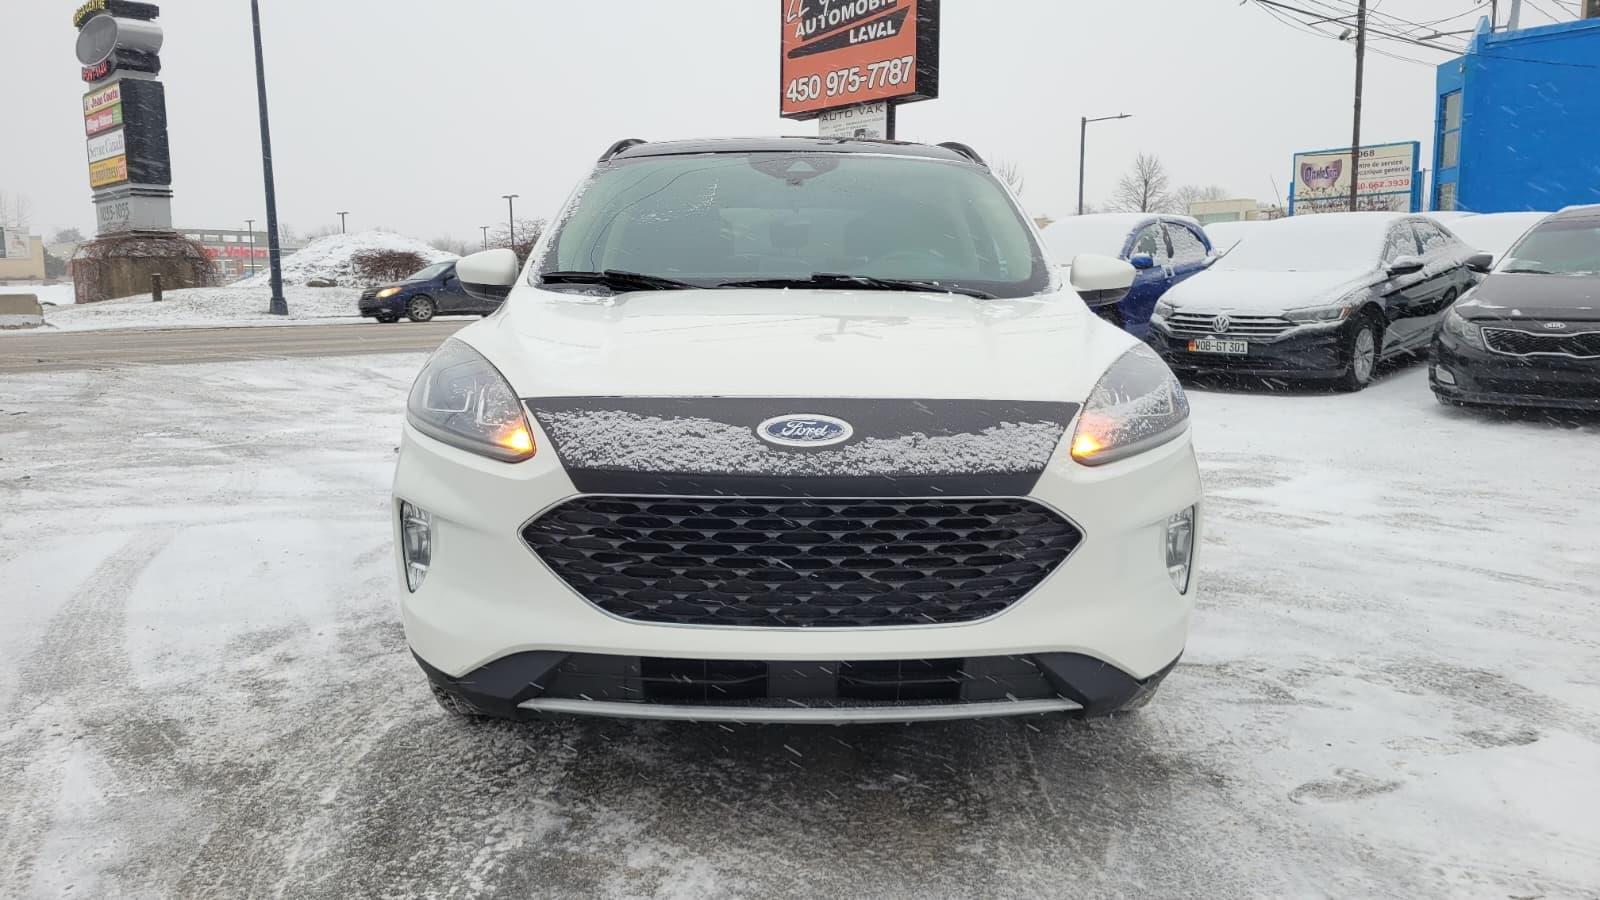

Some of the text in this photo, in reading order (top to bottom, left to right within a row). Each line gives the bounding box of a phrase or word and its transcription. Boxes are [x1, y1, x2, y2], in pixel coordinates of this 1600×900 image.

[849, 19, 896, 44] LAVAL
[786, 55, 914, 103] 450 975-7787
[821, 103, 885, 122] AUTO VAK
[1359, 149, 1375, 158] 068
[1229, 341, 1247, 353] 301
[782, 420, 829, 437] Ford
